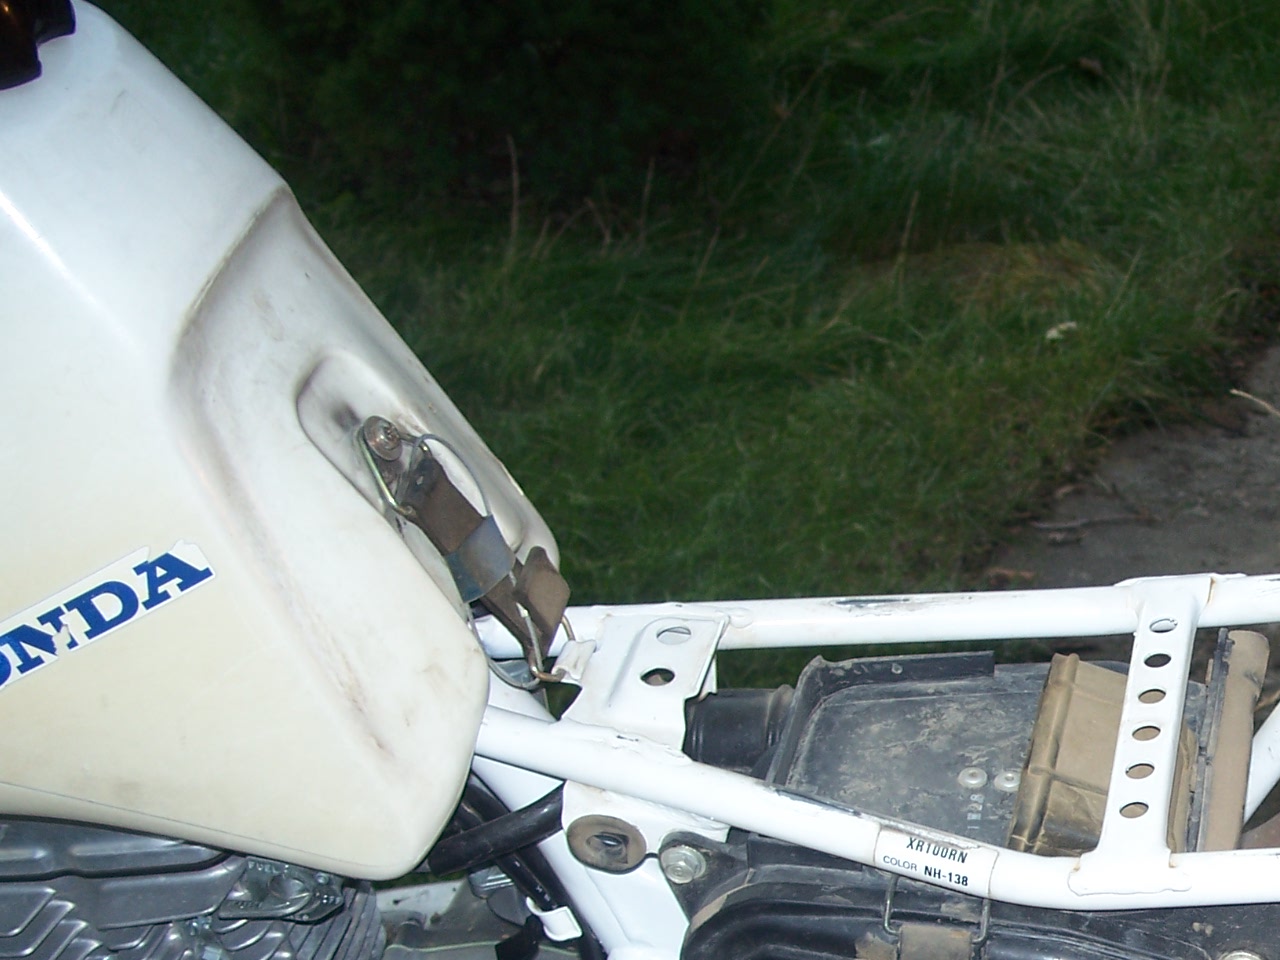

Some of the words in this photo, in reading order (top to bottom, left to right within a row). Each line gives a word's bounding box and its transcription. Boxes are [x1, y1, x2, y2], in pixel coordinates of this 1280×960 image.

[0, 551, 213, 687] NDA
[906, 837, 968, 864] XR100RN
[883, 855, 918, 871] COLOR
[924, 865, 969, 886] NH-138
